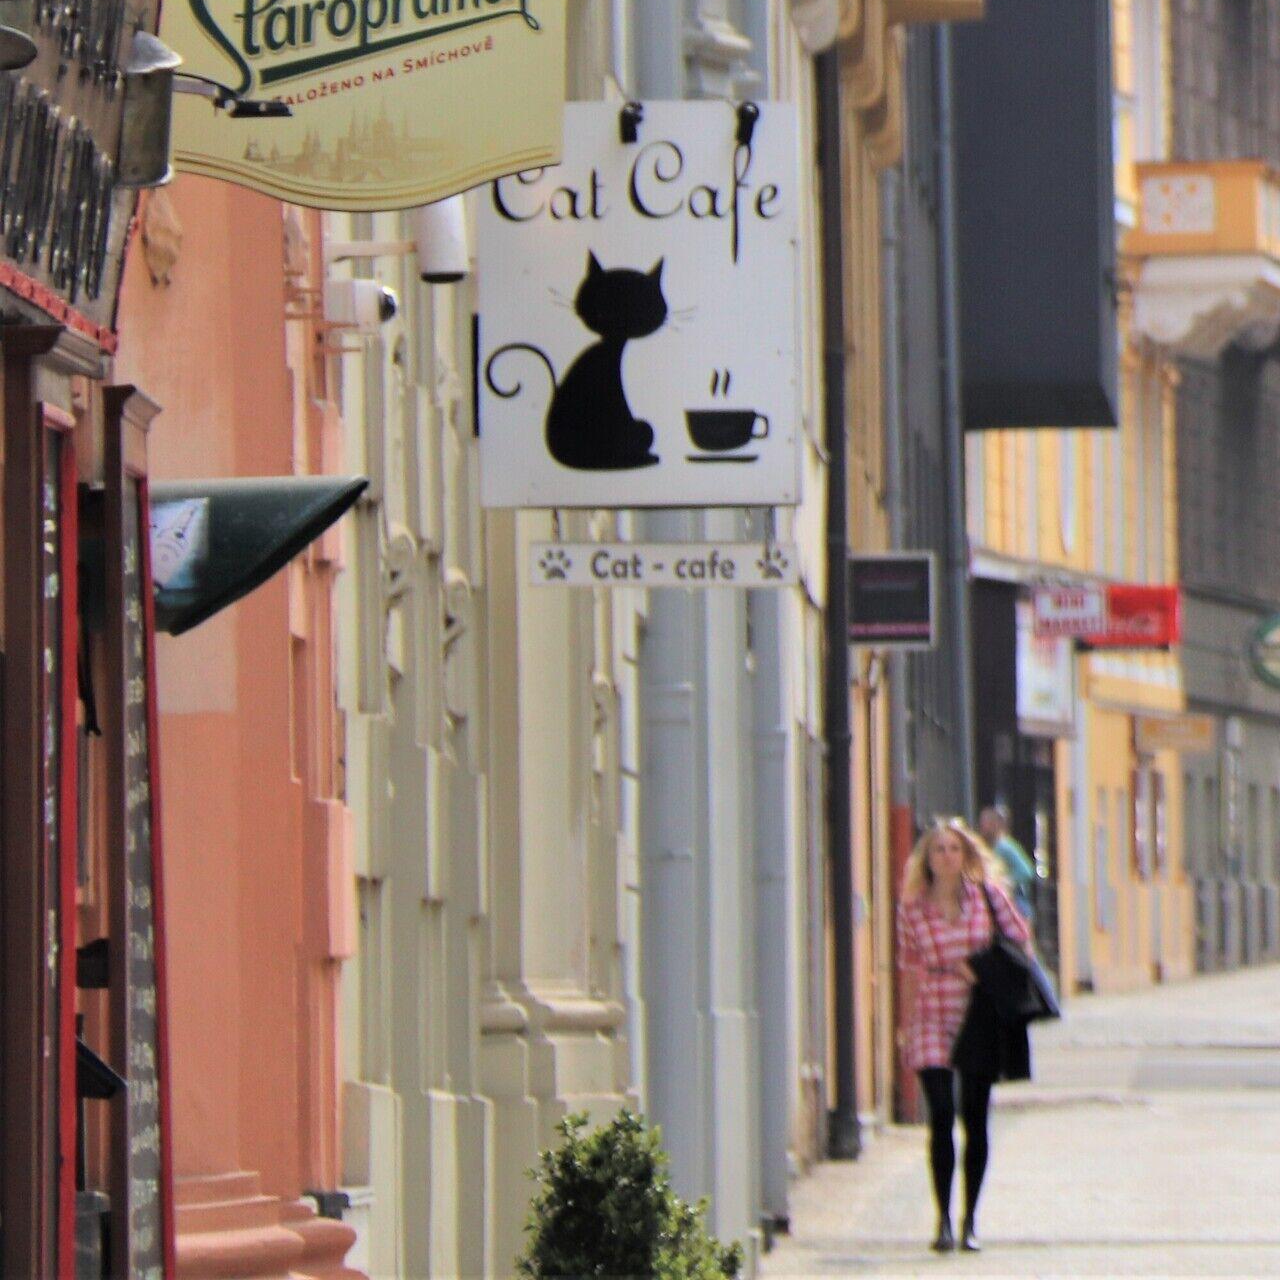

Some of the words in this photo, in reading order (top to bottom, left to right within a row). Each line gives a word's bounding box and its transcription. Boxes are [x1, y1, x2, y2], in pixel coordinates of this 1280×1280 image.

[371, 66, 395, 82] NA
[492, 165, 609, 222] Cat
[628, 140, 782, 265] Cafe
[589, 550, 643, 580] Cat
[673, 548, 737, 580] cafe
